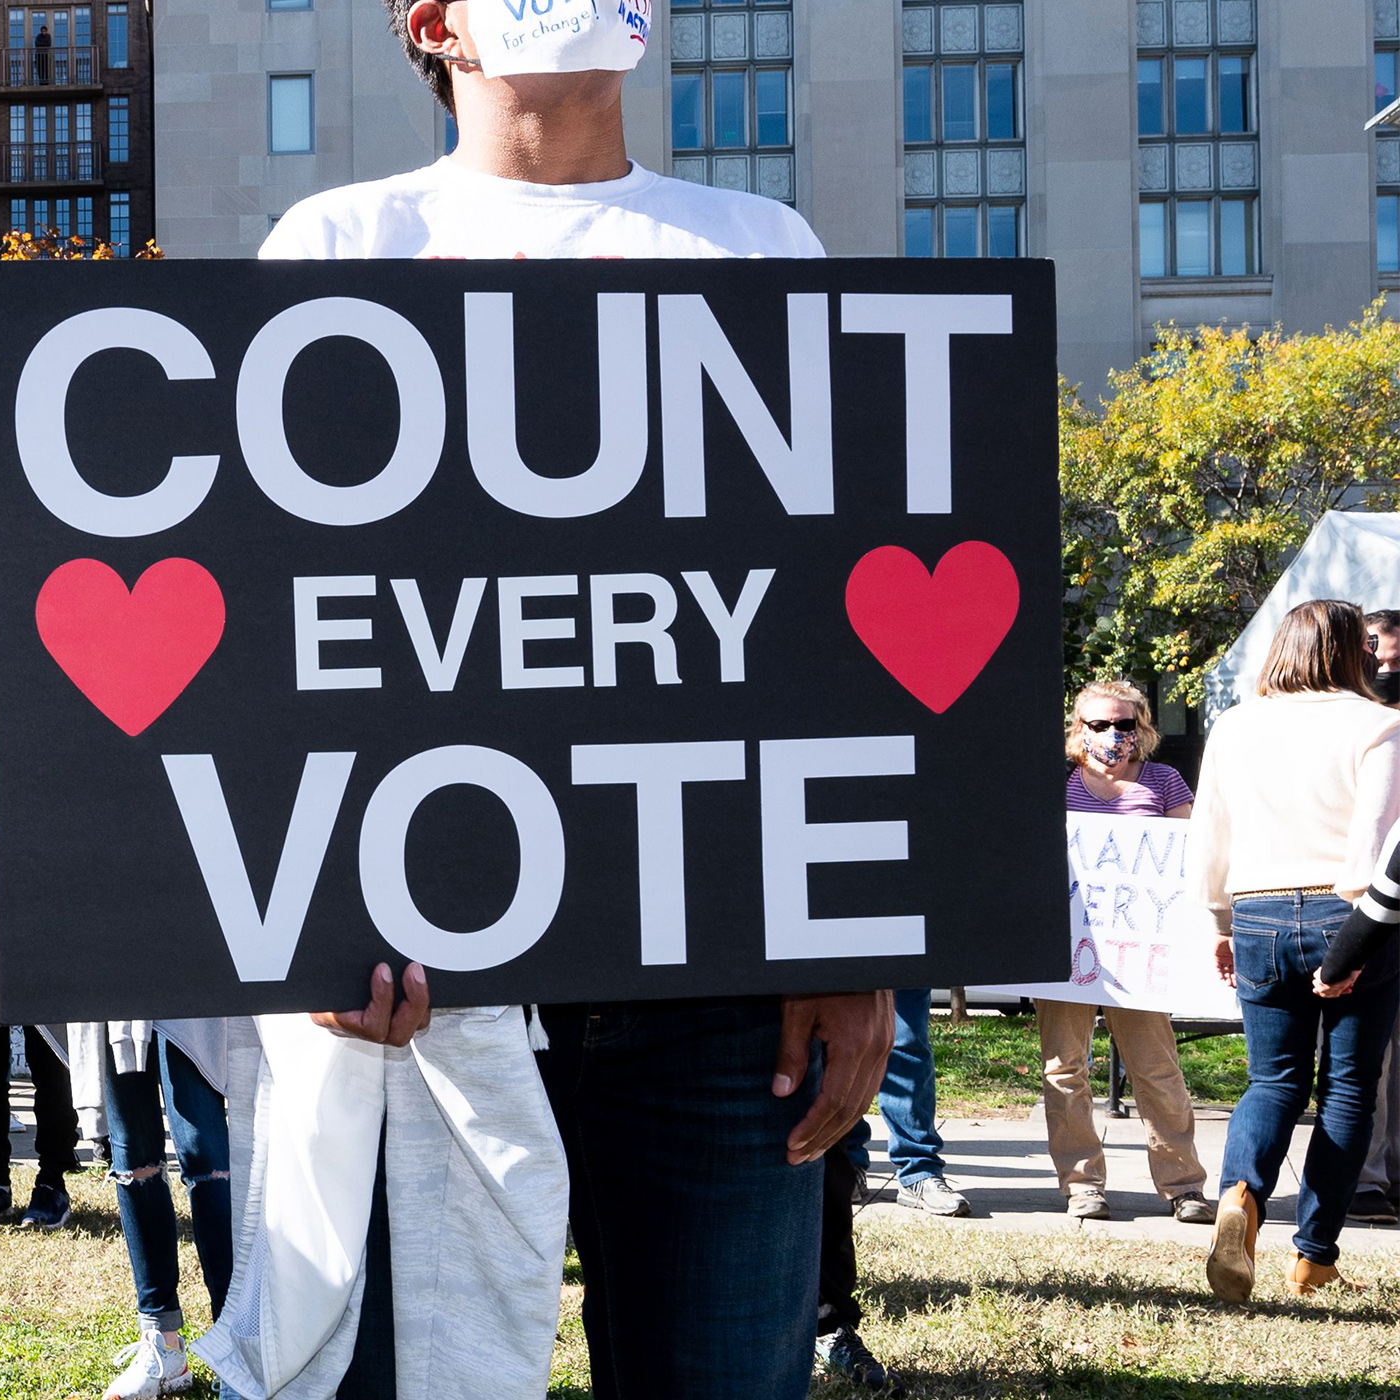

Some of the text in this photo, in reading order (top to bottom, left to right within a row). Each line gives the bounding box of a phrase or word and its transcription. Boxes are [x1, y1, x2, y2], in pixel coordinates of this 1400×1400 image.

[502, 32, 525, 50] For
[16, 293, 1012, 537] COUNT
[294, 569, 776, 691] EVERY
[161, 736, 925, 982] VOTE
